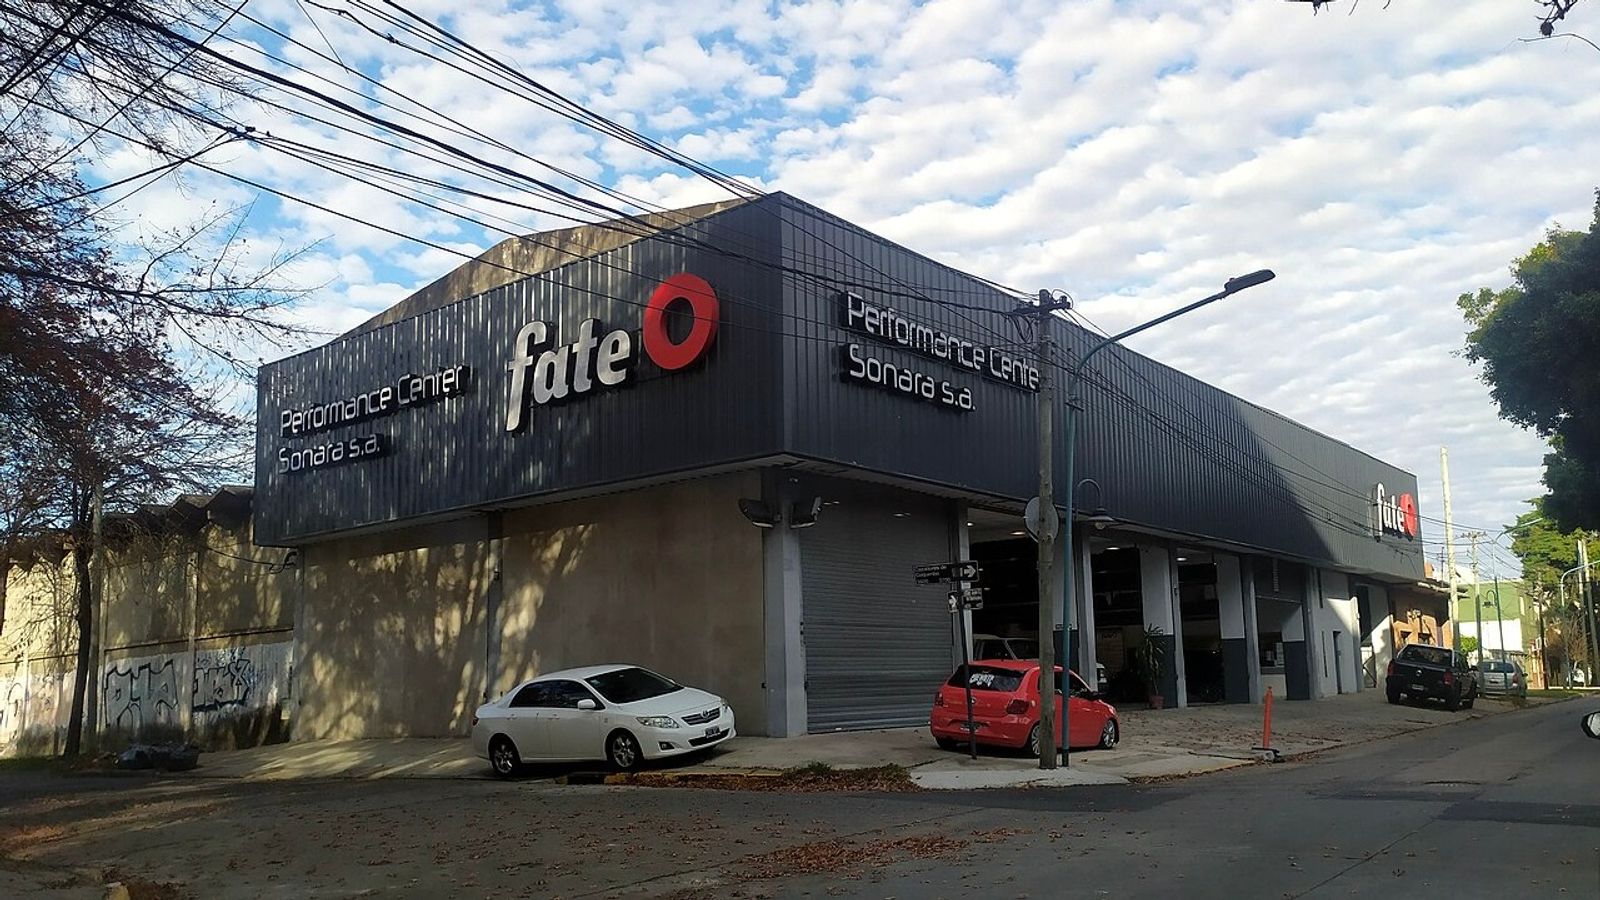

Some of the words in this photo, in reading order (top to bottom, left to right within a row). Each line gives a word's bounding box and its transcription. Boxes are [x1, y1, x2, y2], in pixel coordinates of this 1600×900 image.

[847, 292, 985, 370] Performance
[990, 347, 1039, 389] Cente
[280, 386, 392, 436] Performance
[397, 366, 463, 404] Center
[849, 344, 935, 399] Sonara
[941, 381, 976, 410] s.a.
[279, 441, 344, 473] Sonara
[349, 433, 380, 457] s.a.
